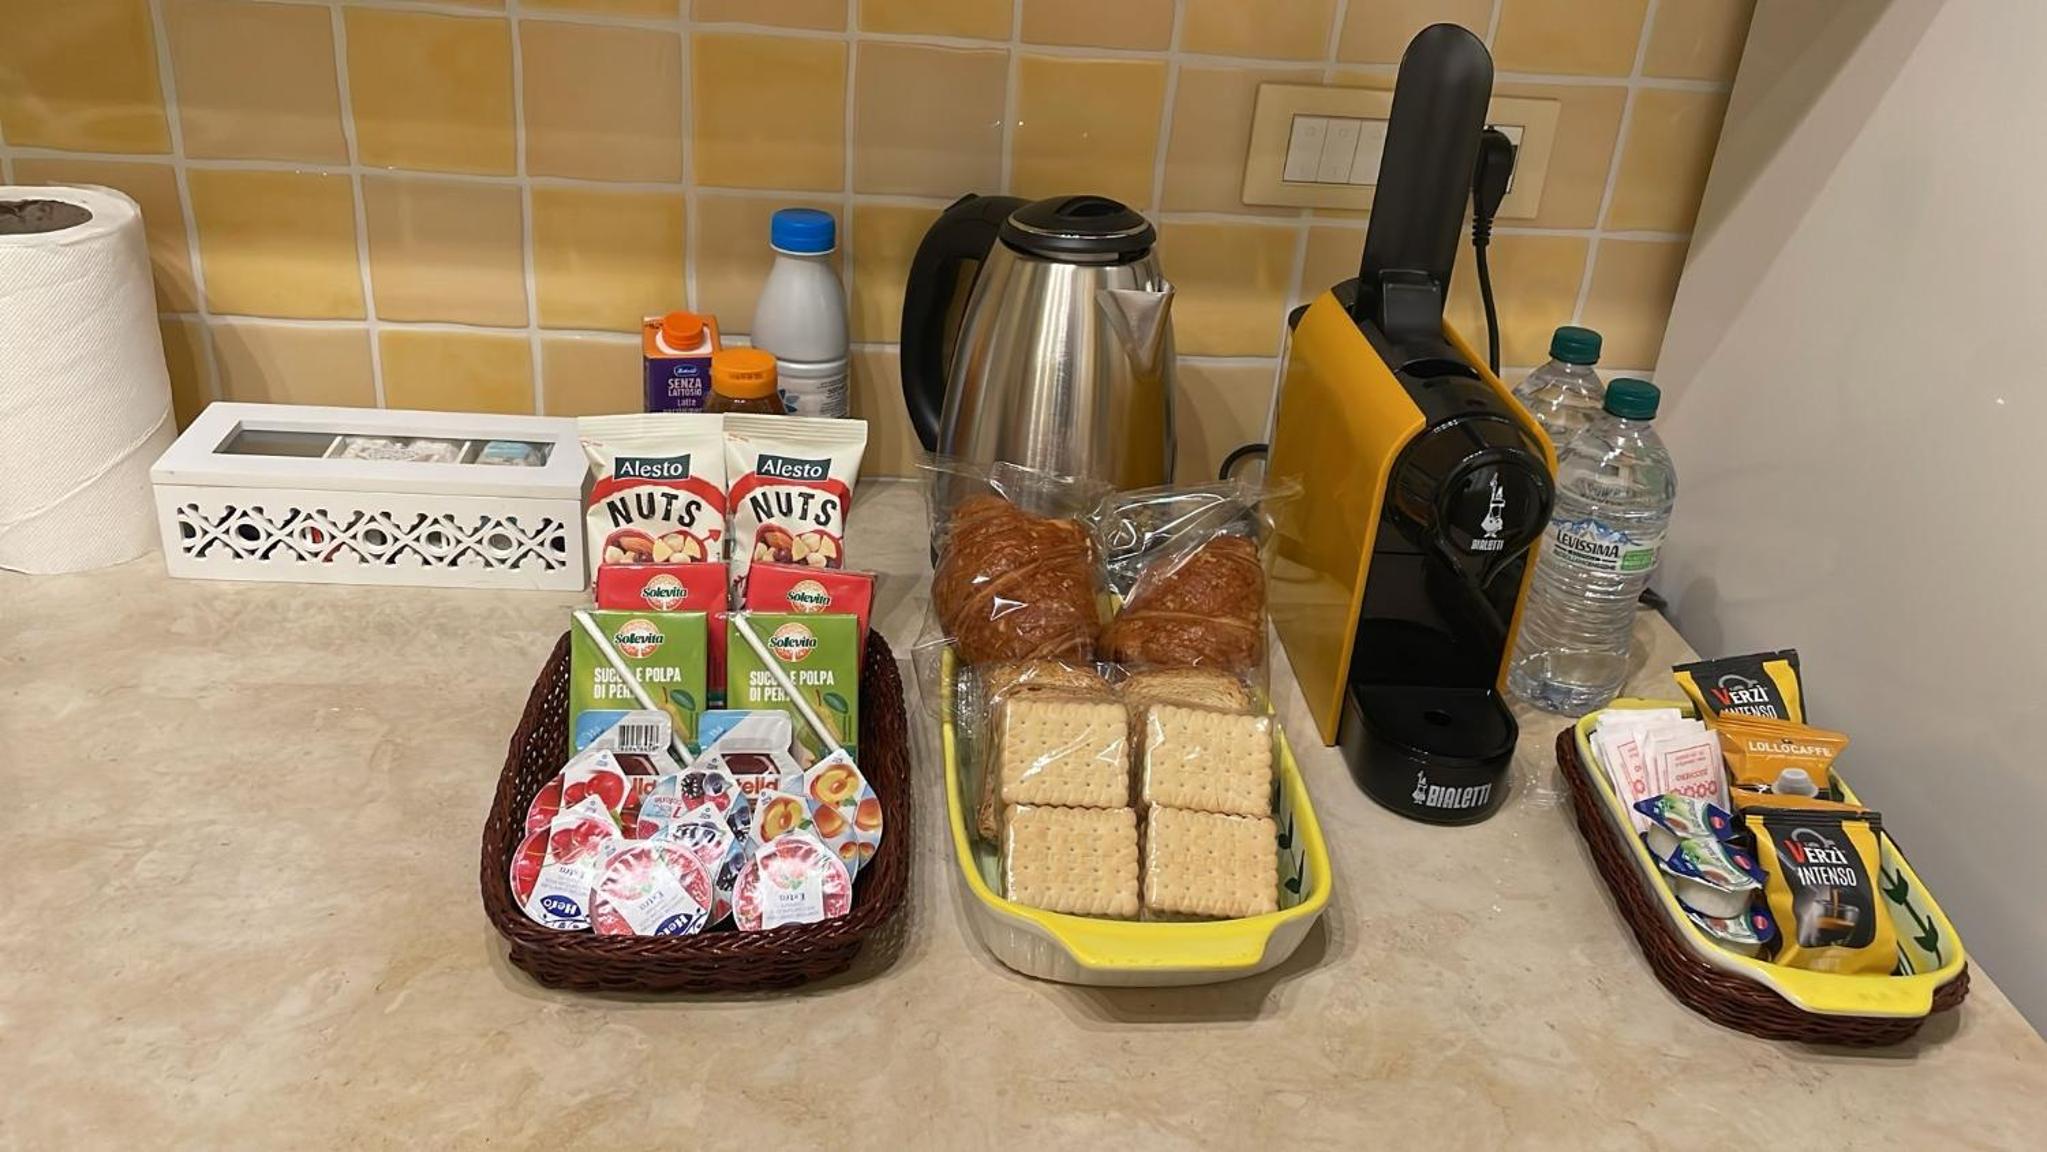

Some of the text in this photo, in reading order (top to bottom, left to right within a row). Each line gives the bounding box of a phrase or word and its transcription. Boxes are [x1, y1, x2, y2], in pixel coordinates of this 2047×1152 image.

[668, 377, 702, 389] SENZA
[668, 389, 702, 397] LATTOSIO
[620, 461, 683, 478] Alesto
[761, 459, 822, 478] Alesto
[607, 492, 702, 528] NUTS
[749, 491, 837, 527] NUTS
[1556, 529, 1619, 558] LEVISSIMA
[642, 586, 688, 600] Solevita
[786, 591, 831, 607] Solevita
[614, 632, 663, 645] Solevita
[768, 635, 817, 650] Solevita
[636, 668, 643, 682] E
[645, 667, 682, 682] POLPA
[799, 671, 834, 686] POLPA
[593, 685, 635, 699] DI PER
[749, 686, 790, 702] DI PER
[1798, 866, 1856, 887] INTENSO
[544, 899, 577, 915] Hero
